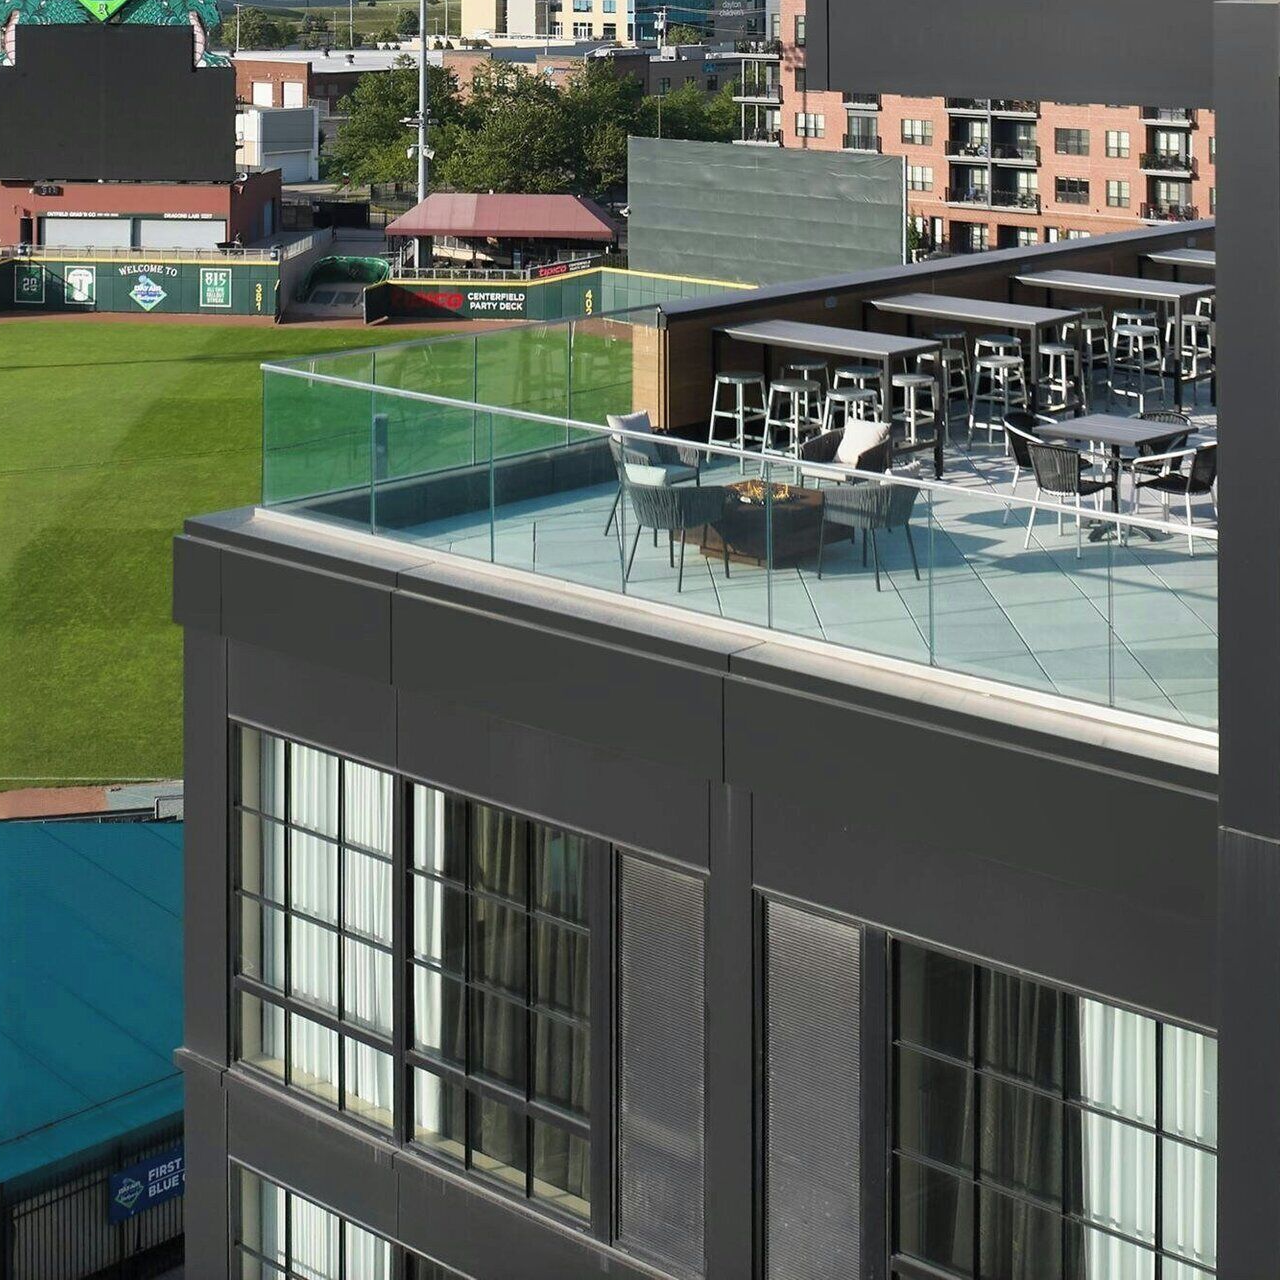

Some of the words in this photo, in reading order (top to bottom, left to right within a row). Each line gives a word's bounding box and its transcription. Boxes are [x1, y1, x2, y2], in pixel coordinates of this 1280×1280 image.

[118, 264, 164, 276] WELCOME
[165, 266, 178, 277] TO
[255, 283, 263, 311] 381
[467, 292, 525, 302] CENTERFIELD
[470, 302, 497, 310] PARTY
[499, 301, 523, 311] DECK
[148, 1157, 182, 1182] FIRST
[148, 1174, 179, 1198] BLUE
